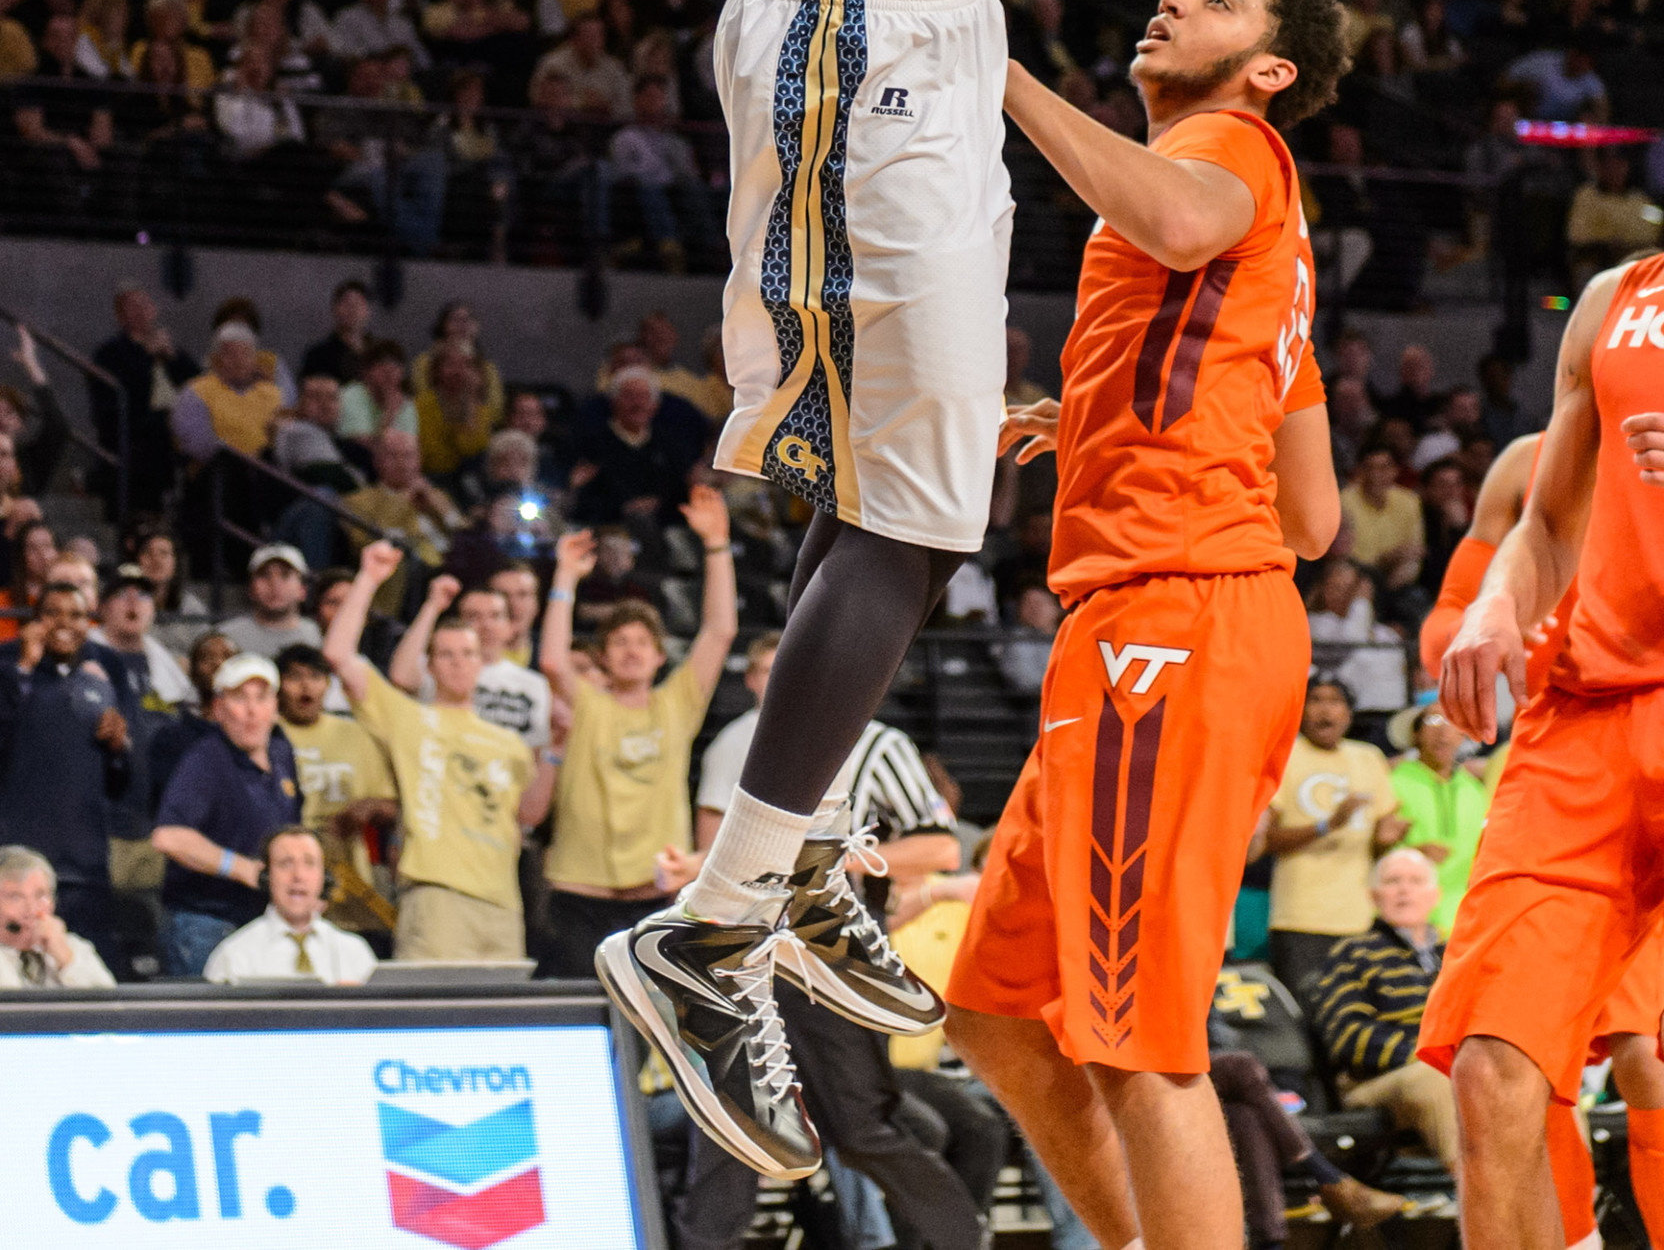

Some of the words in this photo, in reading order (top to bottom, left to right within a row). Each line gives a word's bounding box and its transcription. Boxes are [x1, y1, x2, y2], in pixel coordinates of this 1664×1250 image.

[871, 106, 915, 118] RUSSELL
[1096, 639, 1195, 696] VT
[373, 1058, 535, 1096] Chevron
[46, 1109, 297, 1226] car.
